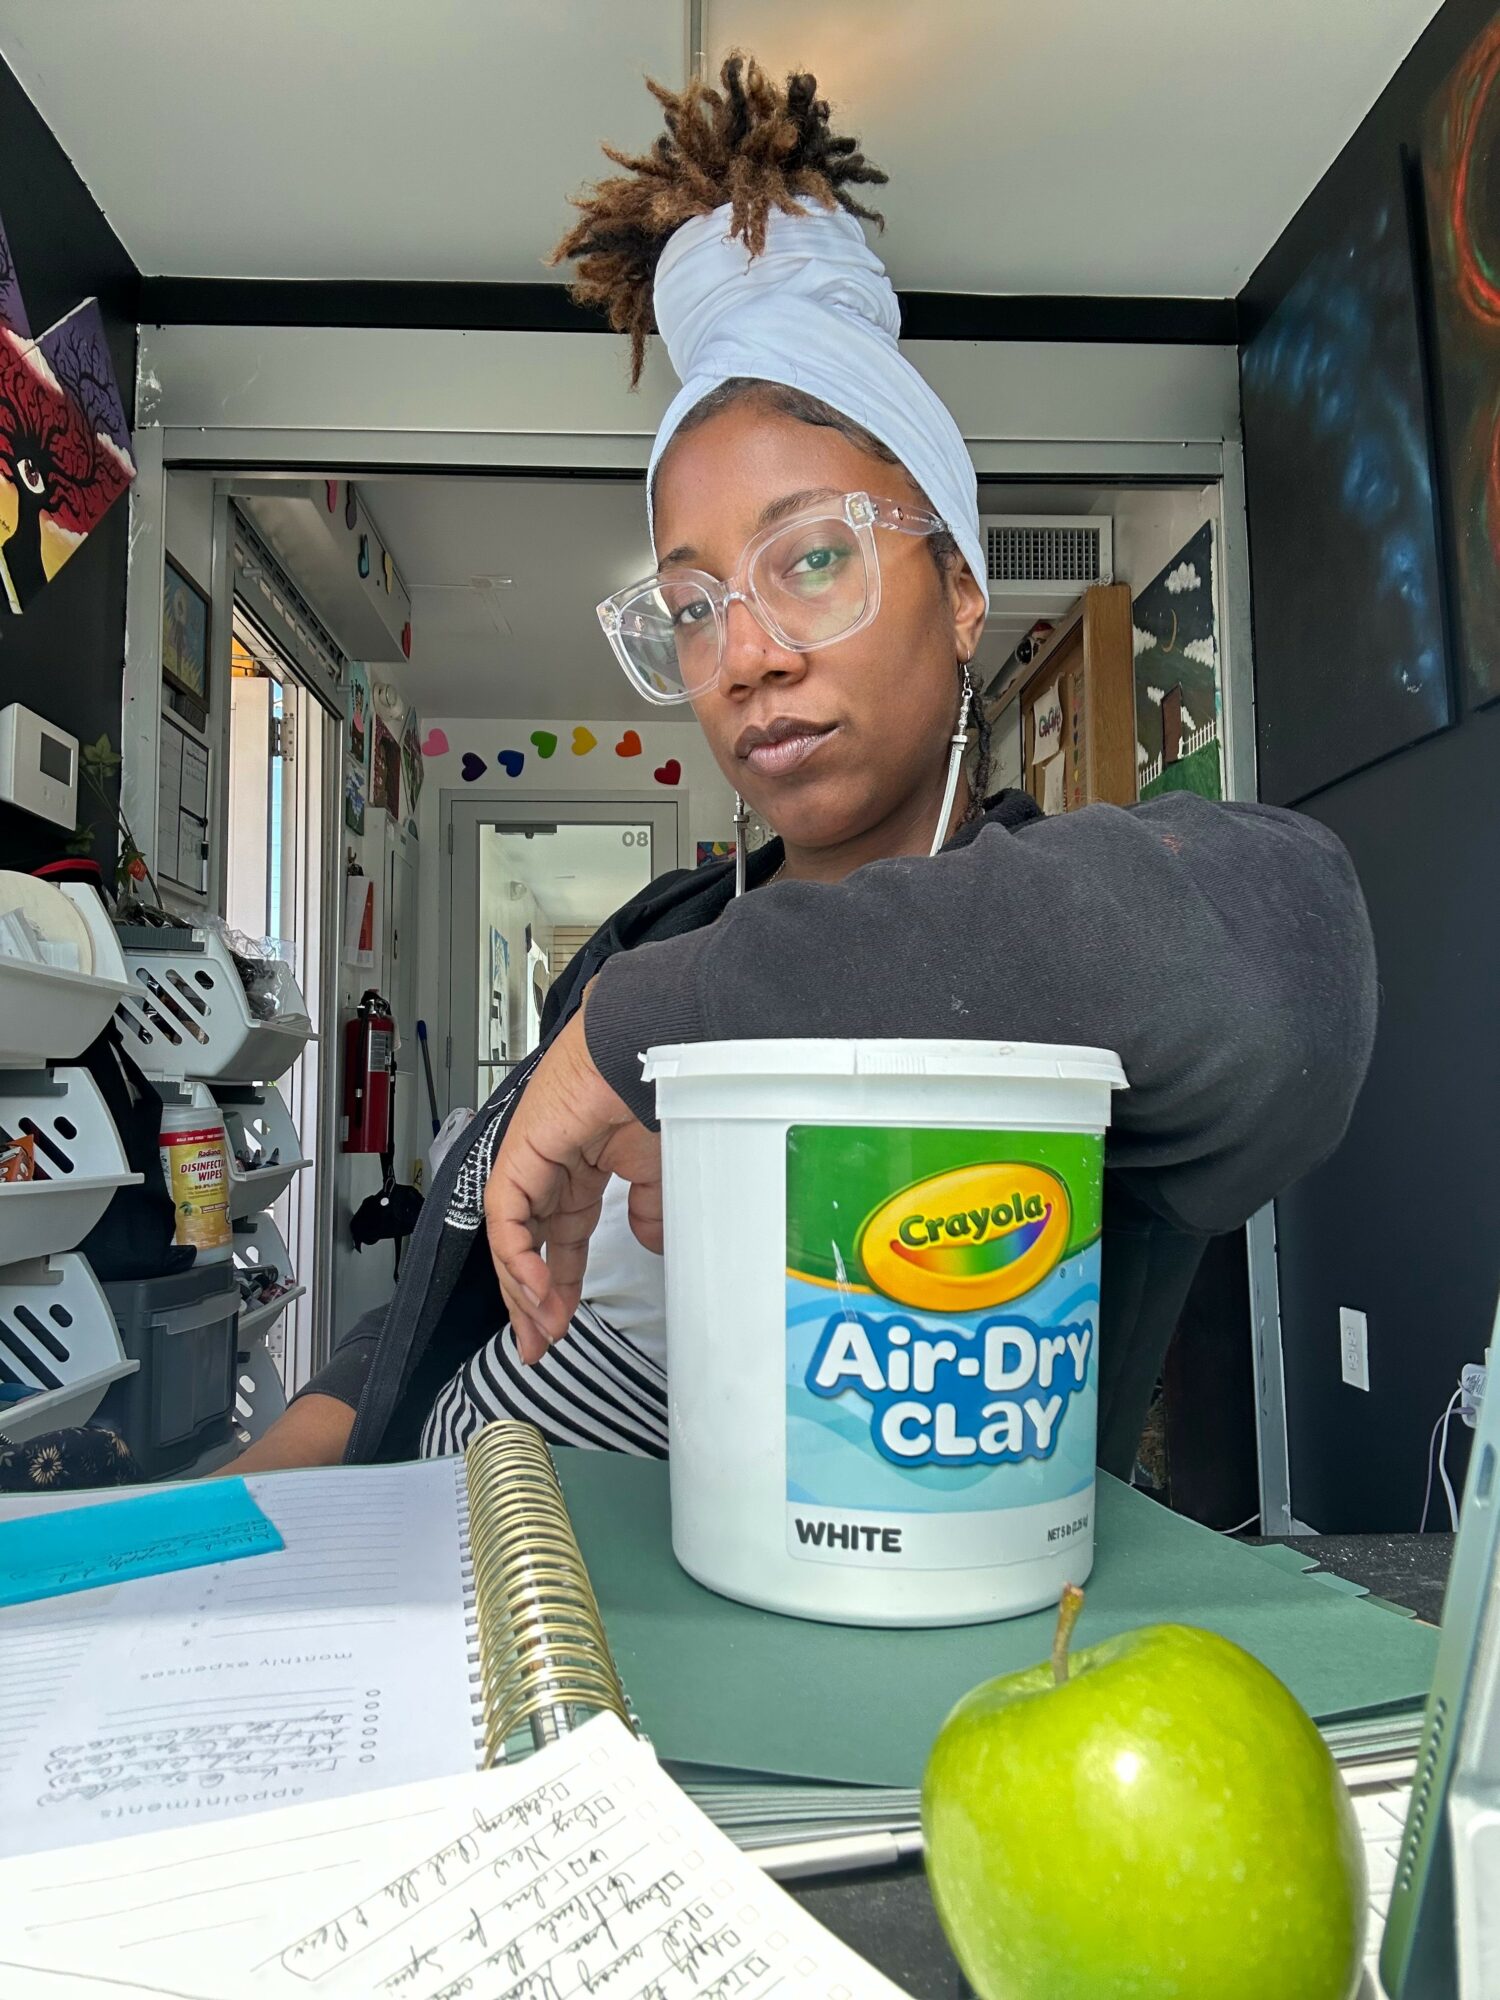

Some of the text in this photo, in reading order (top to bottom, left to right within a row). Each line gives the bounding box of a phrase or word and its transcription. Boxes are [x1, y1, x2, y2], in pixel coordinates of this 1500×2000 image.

[622, 831, 649, 847] 08
[198, 1169, 222, 1181] WIPES
[899, 1192, 1044, 1247] Crayola
[815, 1321, 1091, 1393] Air-Dry
[795, 1518, 902, 1553] WHITE
[1048, 1527, 1060, 1541] NET
[140, 1651, 353, 1680] monthly expenses
[101, 1787, 304, 1819] appointments
[494, 1835, 550, 1878] New
